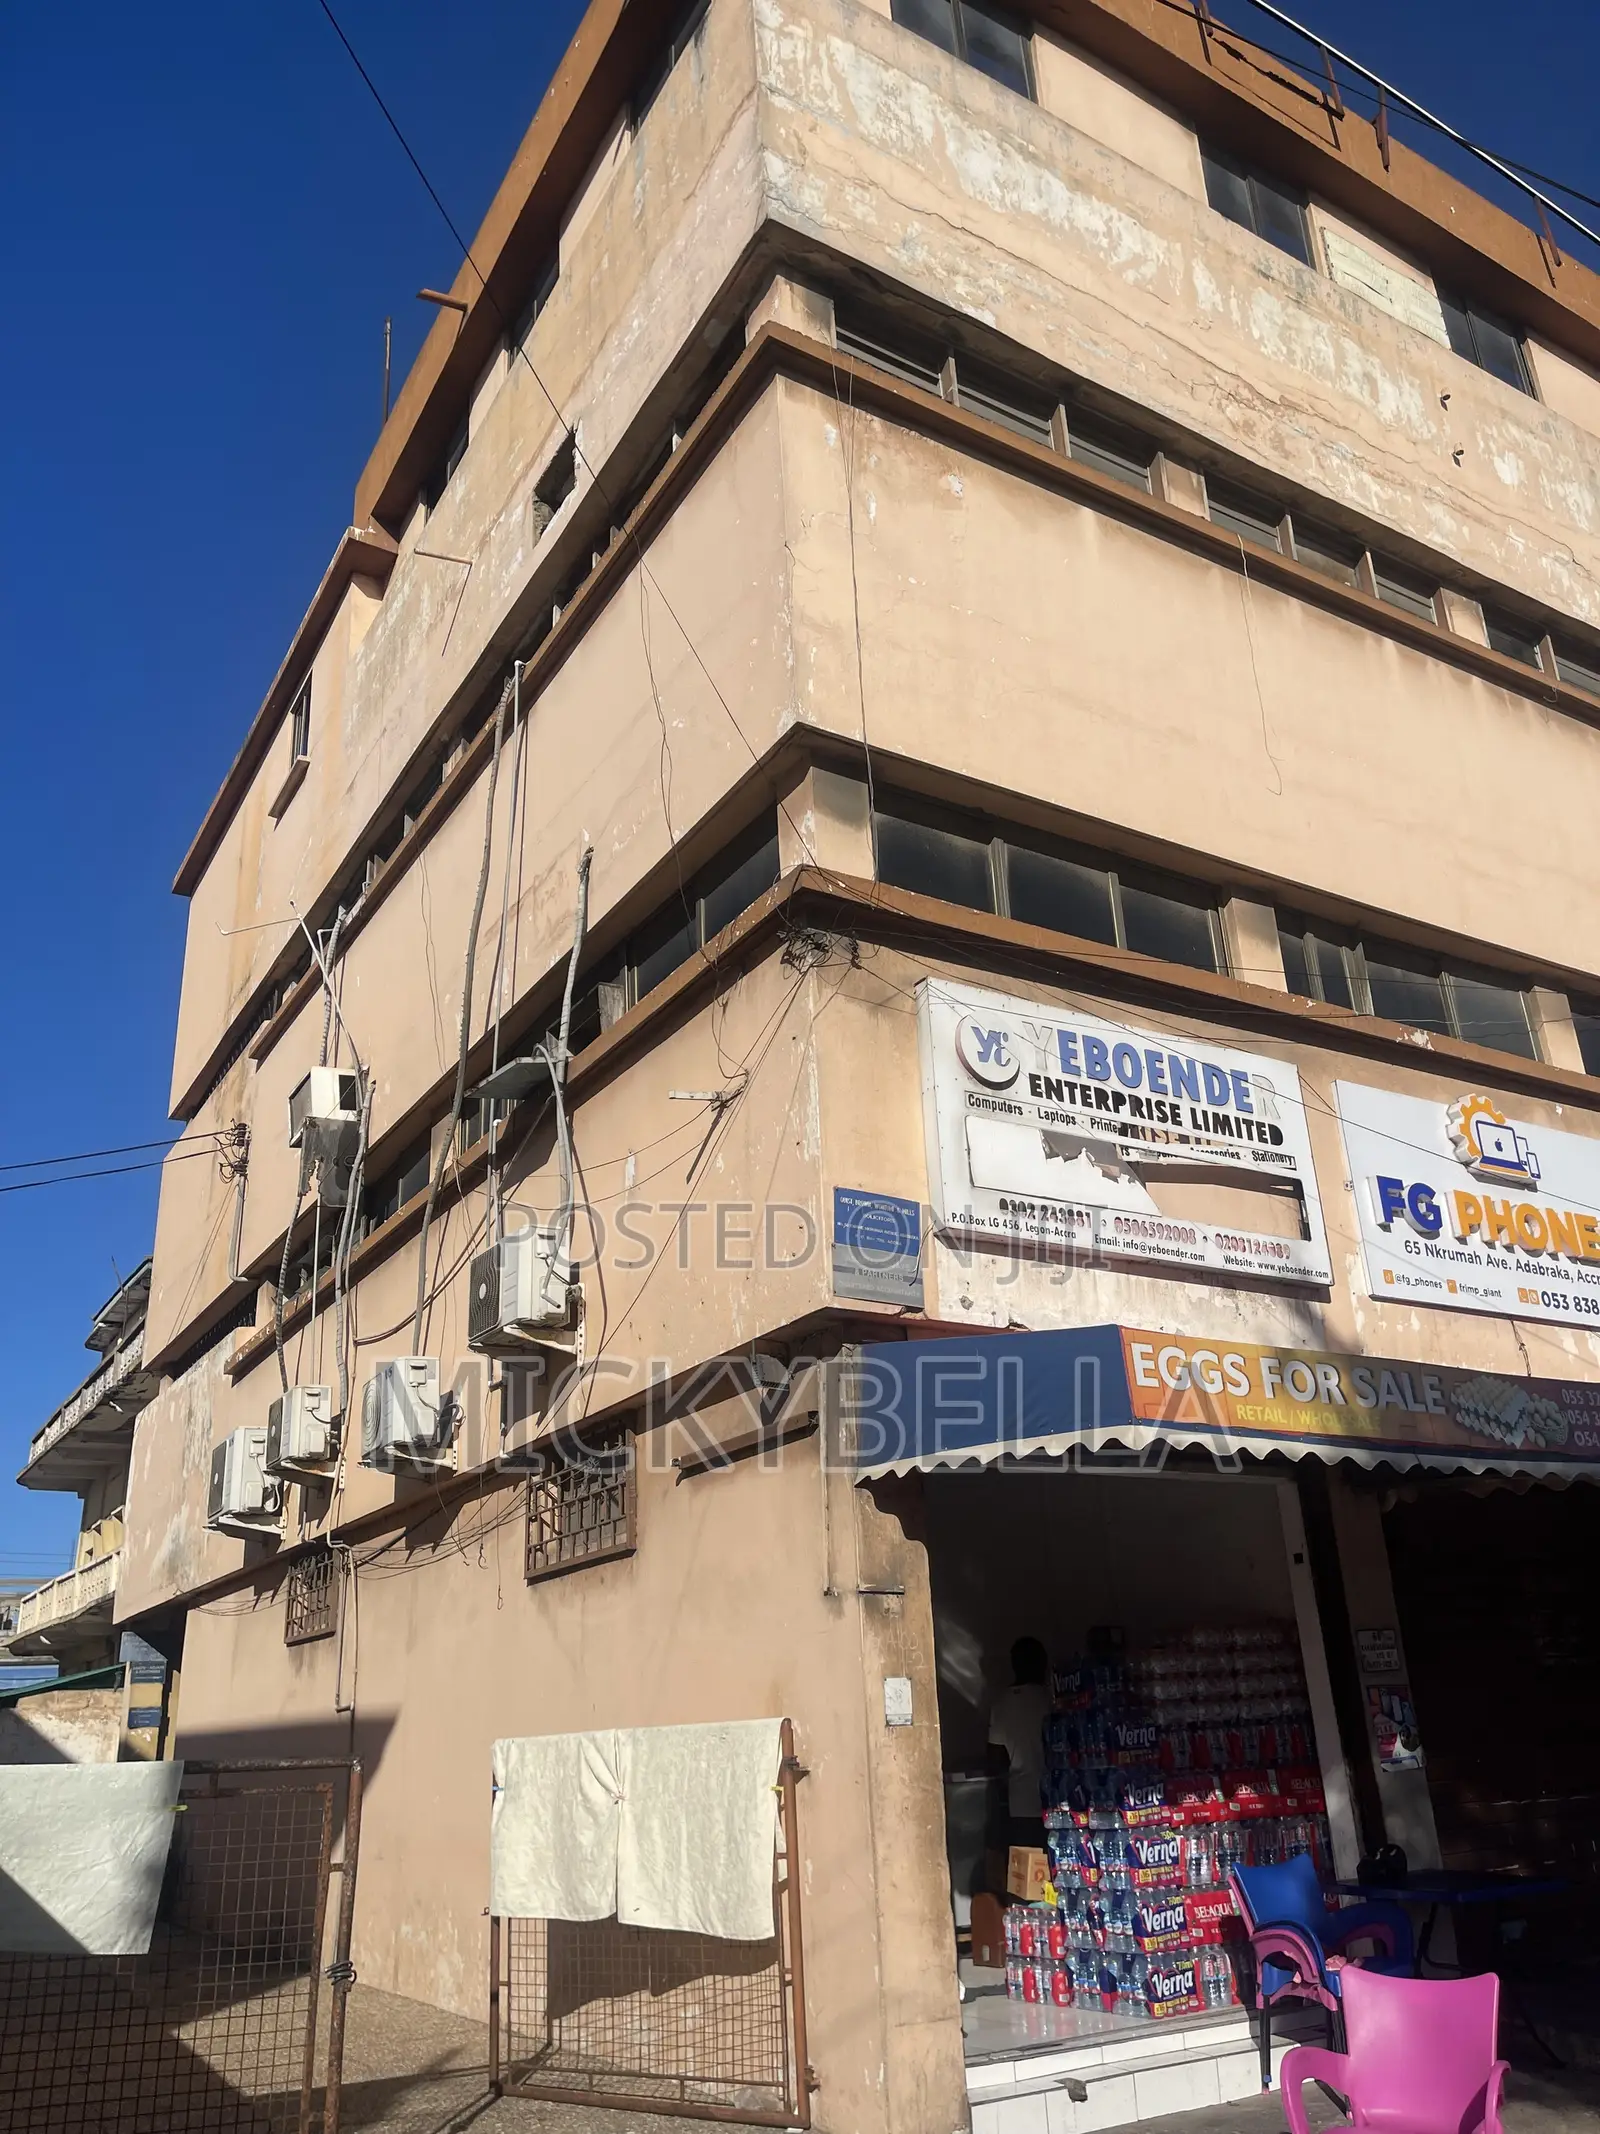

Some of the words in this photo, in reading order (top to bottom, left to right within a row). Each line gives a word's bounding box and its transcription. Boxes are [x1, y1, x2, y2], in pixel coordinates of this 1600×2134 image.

[968, 1094, 1024, 1116] Computers
[1037, 1107, 1077, 1126] Laptops
[1028, 1073, 1183, 1126] ENTERPRISE
[1190, 1107, 1284, 1146] LIMITED
[1370, 1175, 1443, 1234] FG
[988, 1217, 1000, 1229] LG
[1002, 1218, 1023, 1233] 456,
[1094, 1233, 1121, 1248] Email:
[1122, 1238, 1206, 1263] info@yeboender.com
[1223, 1254, 1256, 1270] Website:
[1257, 1261, 1330, 1280] www.yeboender.com
[1404, 1240, 1421, 1256] 65
[1425, 1243, 1482, 1266] Nkrumah
[1486, 1253, 1512, 1271] Ave.
[1515, 1259, 1574, 1284] Adabraka,
[863, 1269, 904, 1282] PARTNERS
[1395, 1272, 1443, 1290] @fg_phones
[1540, 1290, 1570, 1312] 053
[1574, 1296, 1600, 1316] 838
[1130, 1342, 1251, 1398] EGGS
[1260, 1357, 1346, 1406] FOR
[1352, 1367, 1447, 1415] SALE
[1236, 1404, 1288, 1424] RETAIL
[1296, 1409, 1382, 1433] WHOLESALE
[1115, 1724, 1156, 1748] Verna
[1124, 1782, 1165, 1807] Verna
[1136, 1840, 1180, 1867] Verna
[1141, 1905, 1184, 1933] Verna
[1151, 1971, 1194, 1998] Verna
